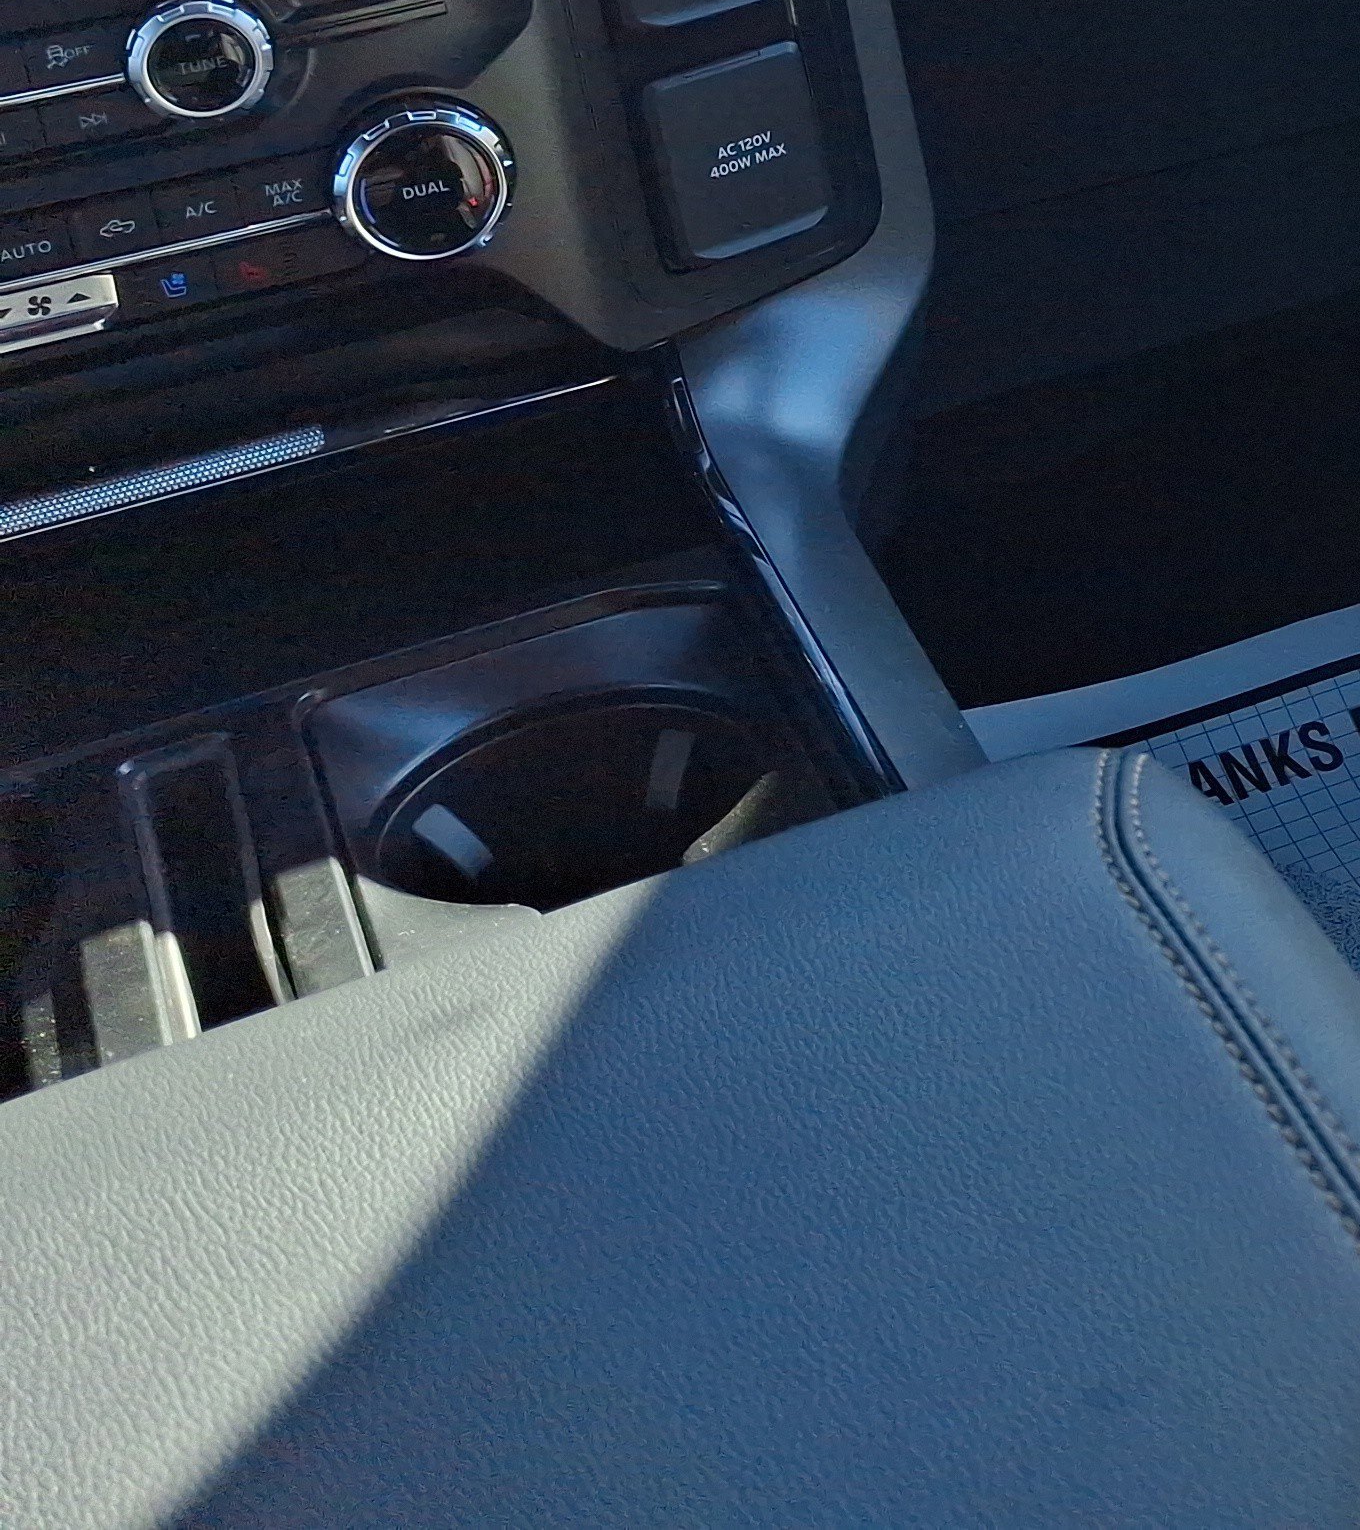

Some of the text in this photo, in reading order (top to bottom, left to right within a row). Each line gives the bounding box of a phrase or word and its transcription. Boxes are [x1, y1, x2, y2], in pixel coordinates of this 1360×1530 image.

[64, 44, 95, 59] OFF
[179, 56, 228, 75] TUNE
[718, 131, 770, 159] AC 120V
[711, 143, 787, 178] 400W MAX
[265, 179, 302, 197] MAX
[402, 180, 450, 200] DUAL
[272, 190, 302, 208] A/C
[186, 201, 217, 219] A/C
[1, 240, 52, 262] AUTO
